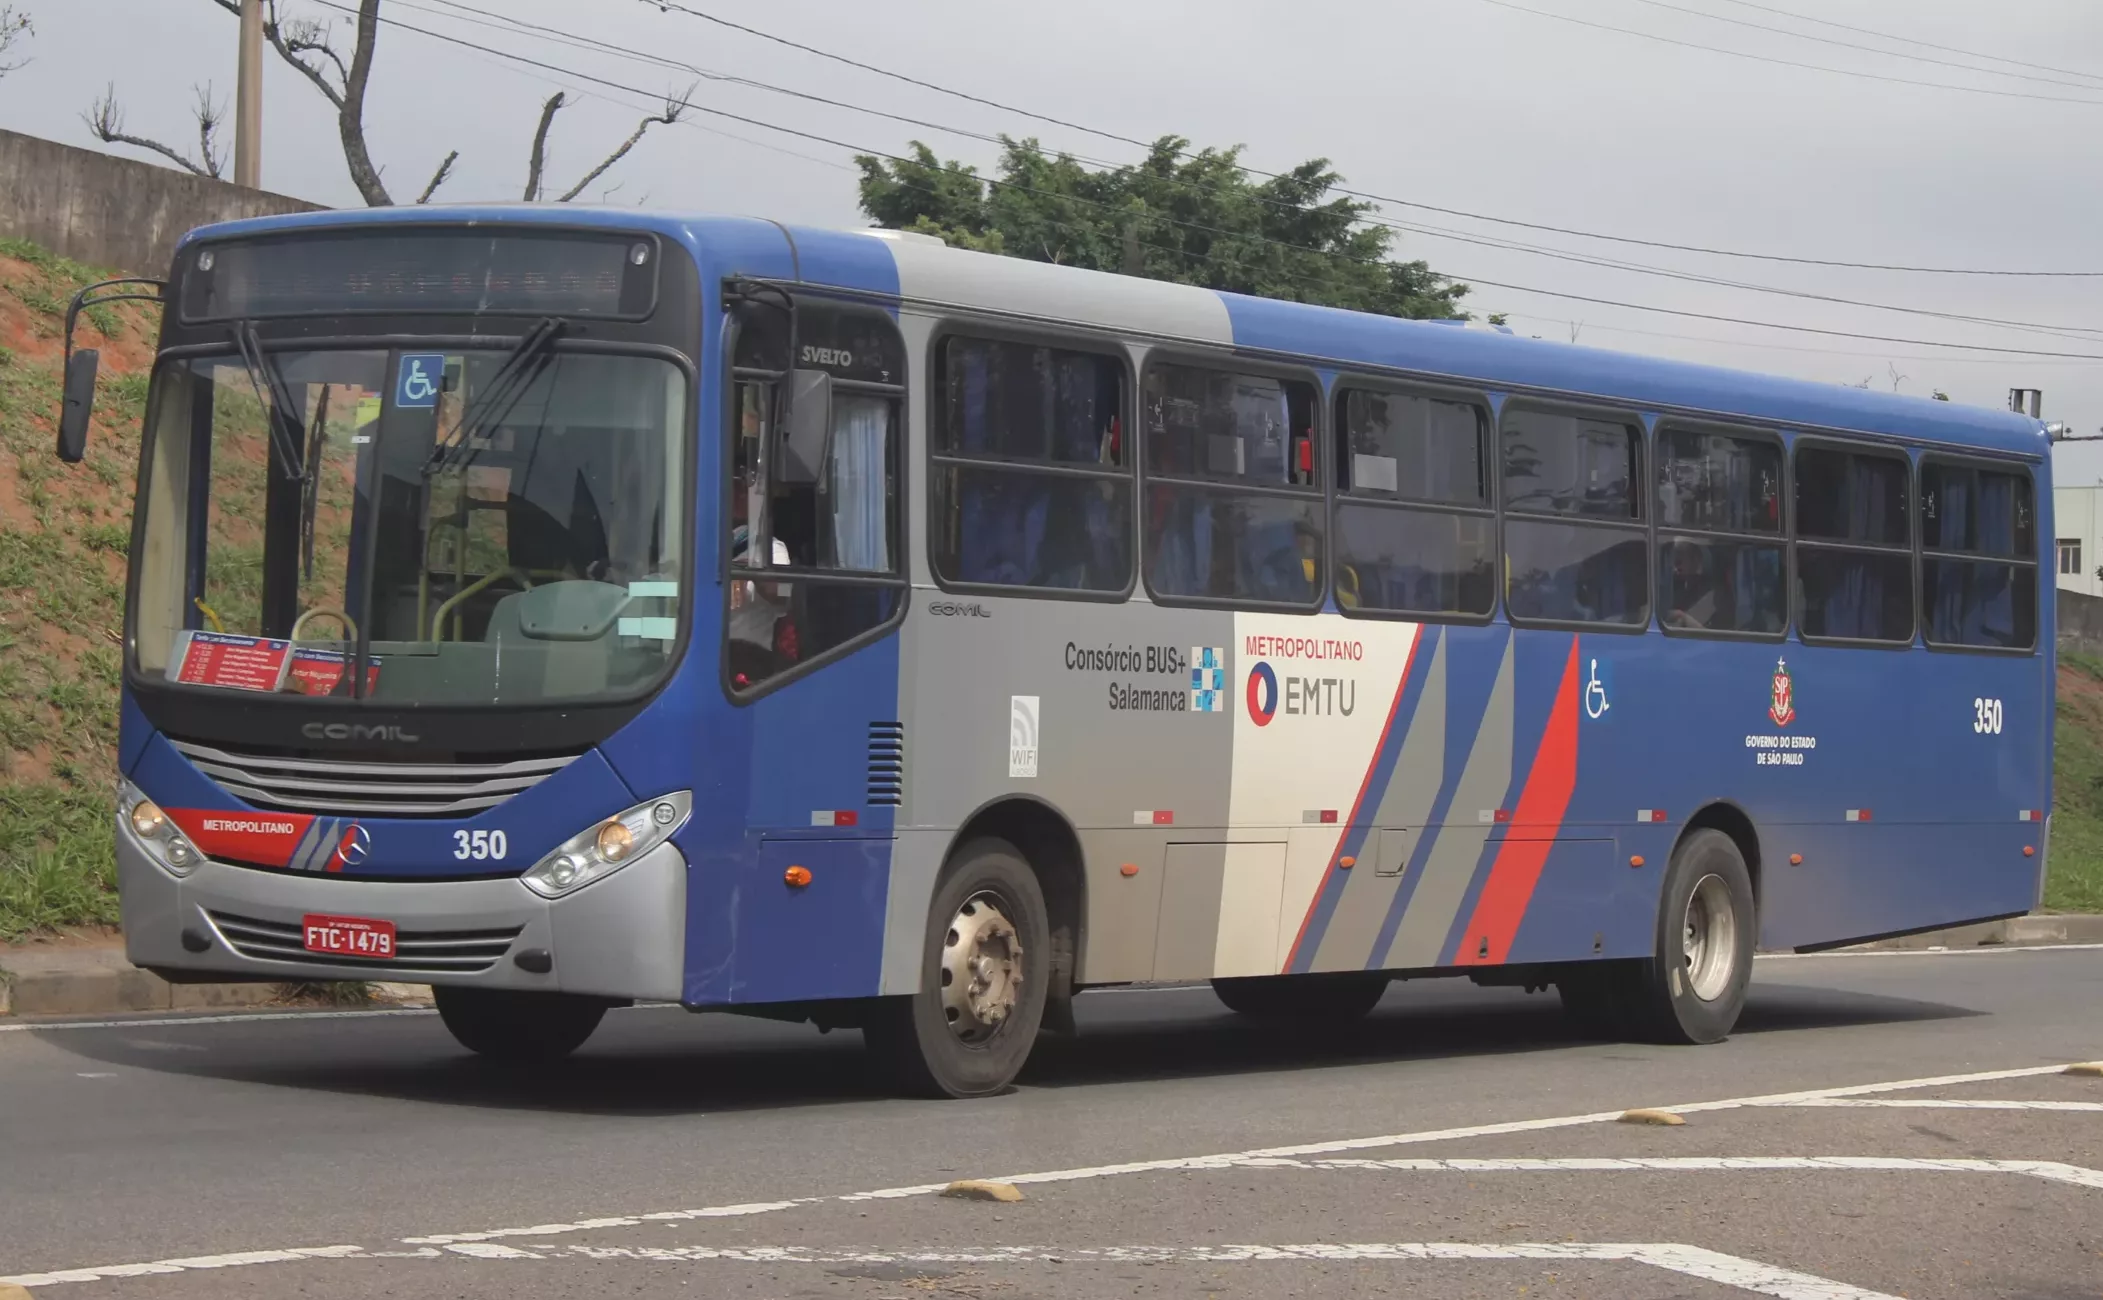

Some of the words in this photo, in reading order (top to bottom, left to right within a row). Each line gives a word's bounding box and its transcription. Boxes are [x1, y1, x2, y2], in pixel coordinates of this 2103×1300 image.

[802, 345, 852, 367] SVELTO
[928, 601, 992, 618] COMIL
[1065, 641, 1142, 673] Consórcio
[1146, 646, 1187, 675] BUS+
[1245, 635, 1363, 661] METROPOLITANO
[1109, 681, 1187, 712] Salamanca
[1285, 676, 1355, 717] EMTU
[1973, 697, 2003, 735] 350
[302, 722, 420, 742] COMIL
[1745, 735, 1779, 748] GOVERNO
[1780, 736, 1791, 748] DO
[1791, 736, 1816, 749] ESTADO
[1011, 749, 1037, 766] WIFI
[1757, 752, 1767, 765] DE
[1767, 749, 1781, 765] SÃO
[1782, 753, 1804, 766] PAULO
[203, 819, 295, 835] METROPOLITANO
[453, 829, 508, 860] 350
